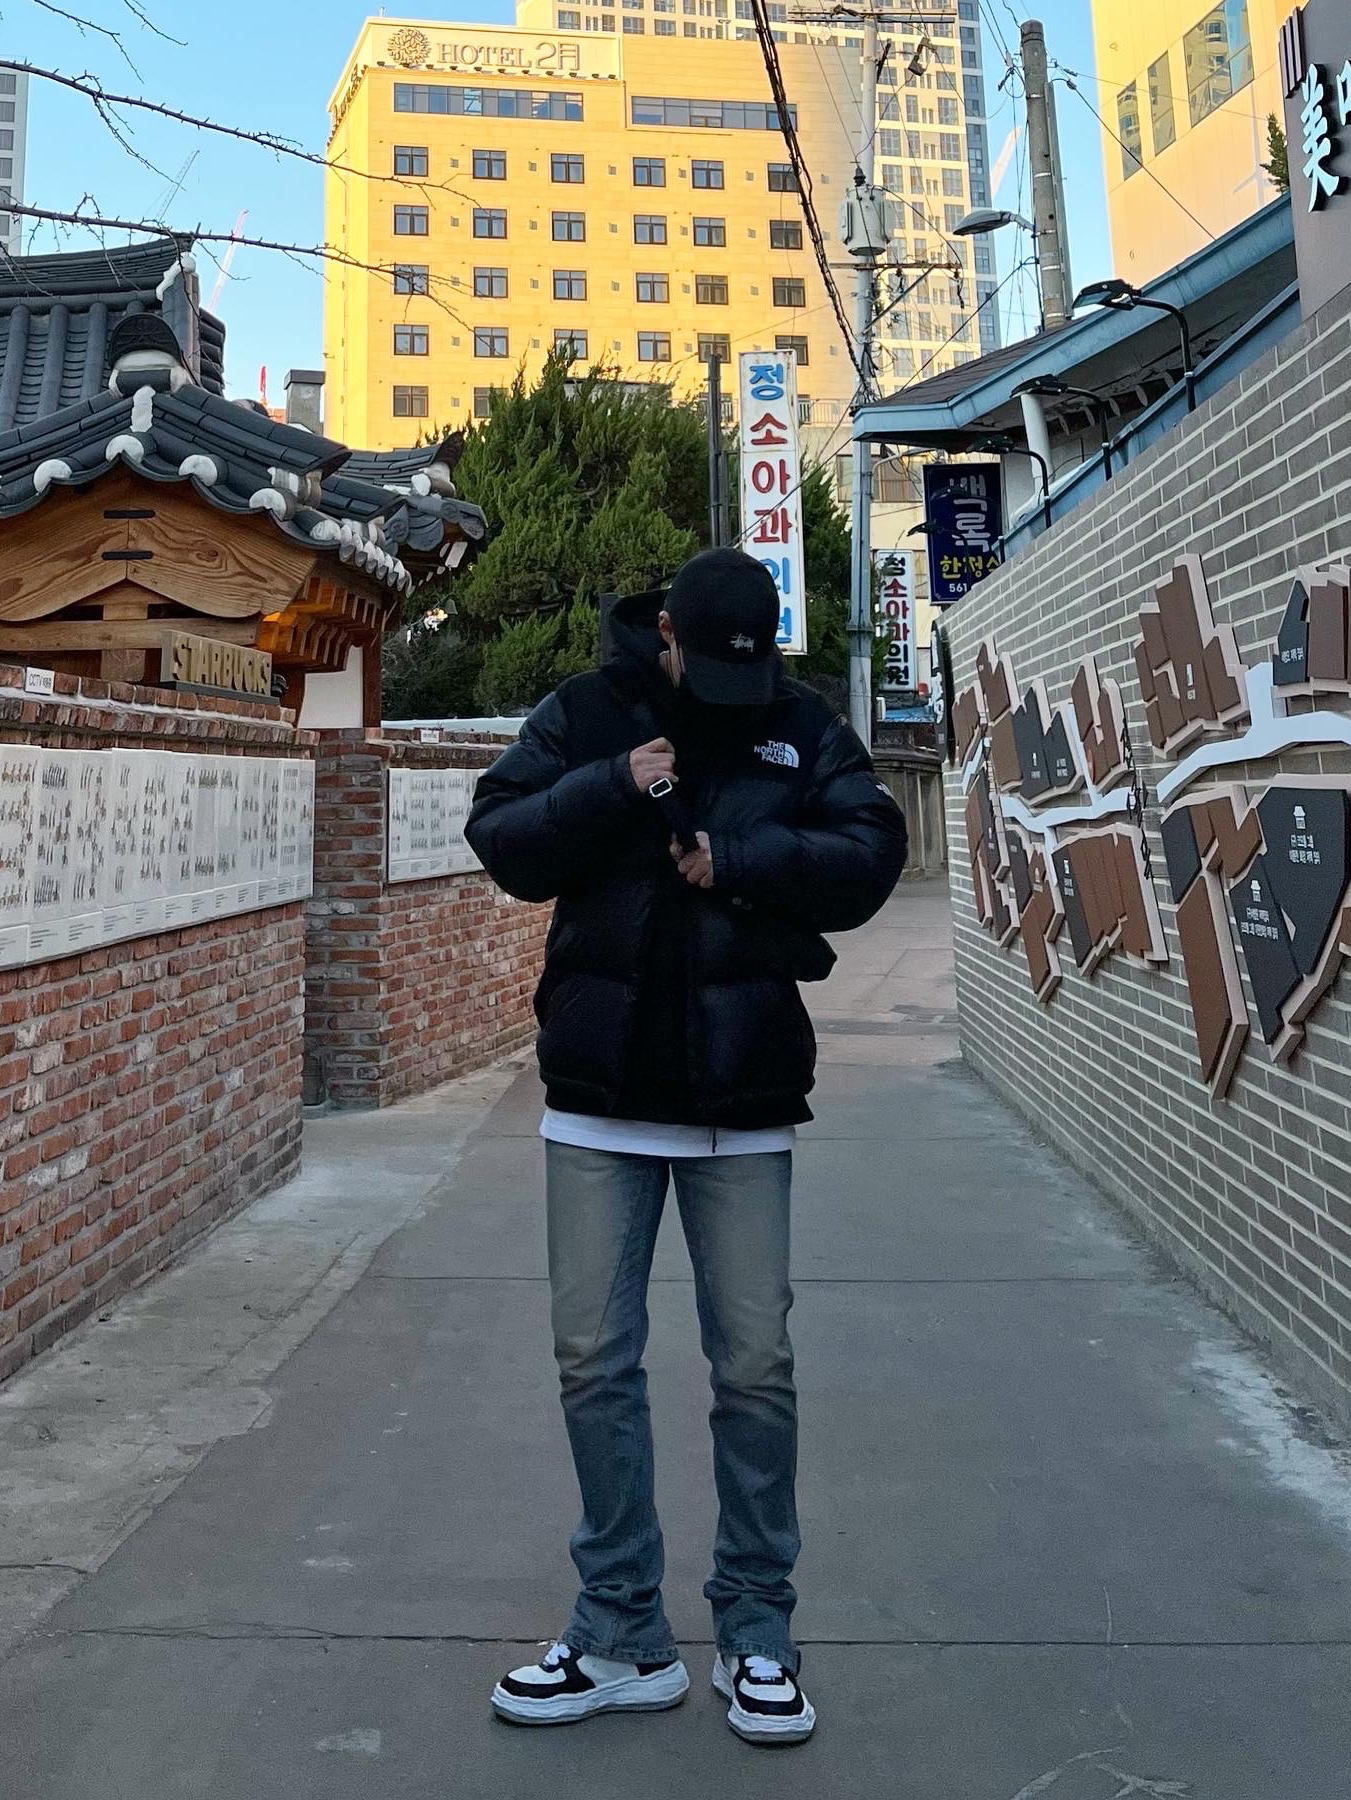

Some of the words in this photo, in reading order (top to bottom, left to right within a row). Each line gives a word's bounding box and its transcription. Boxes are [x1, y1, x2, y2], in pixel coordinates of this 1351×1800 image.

[436, 42, 532, 68] HOTEL
[1300, 59, 1351, 214] 美
[171, 637, 270, 696] STARBUCKS
[753, 745, 785, 758] NORTH
[767, 740, 785, 751] THE
[761, 755, 785, 765] FACE
